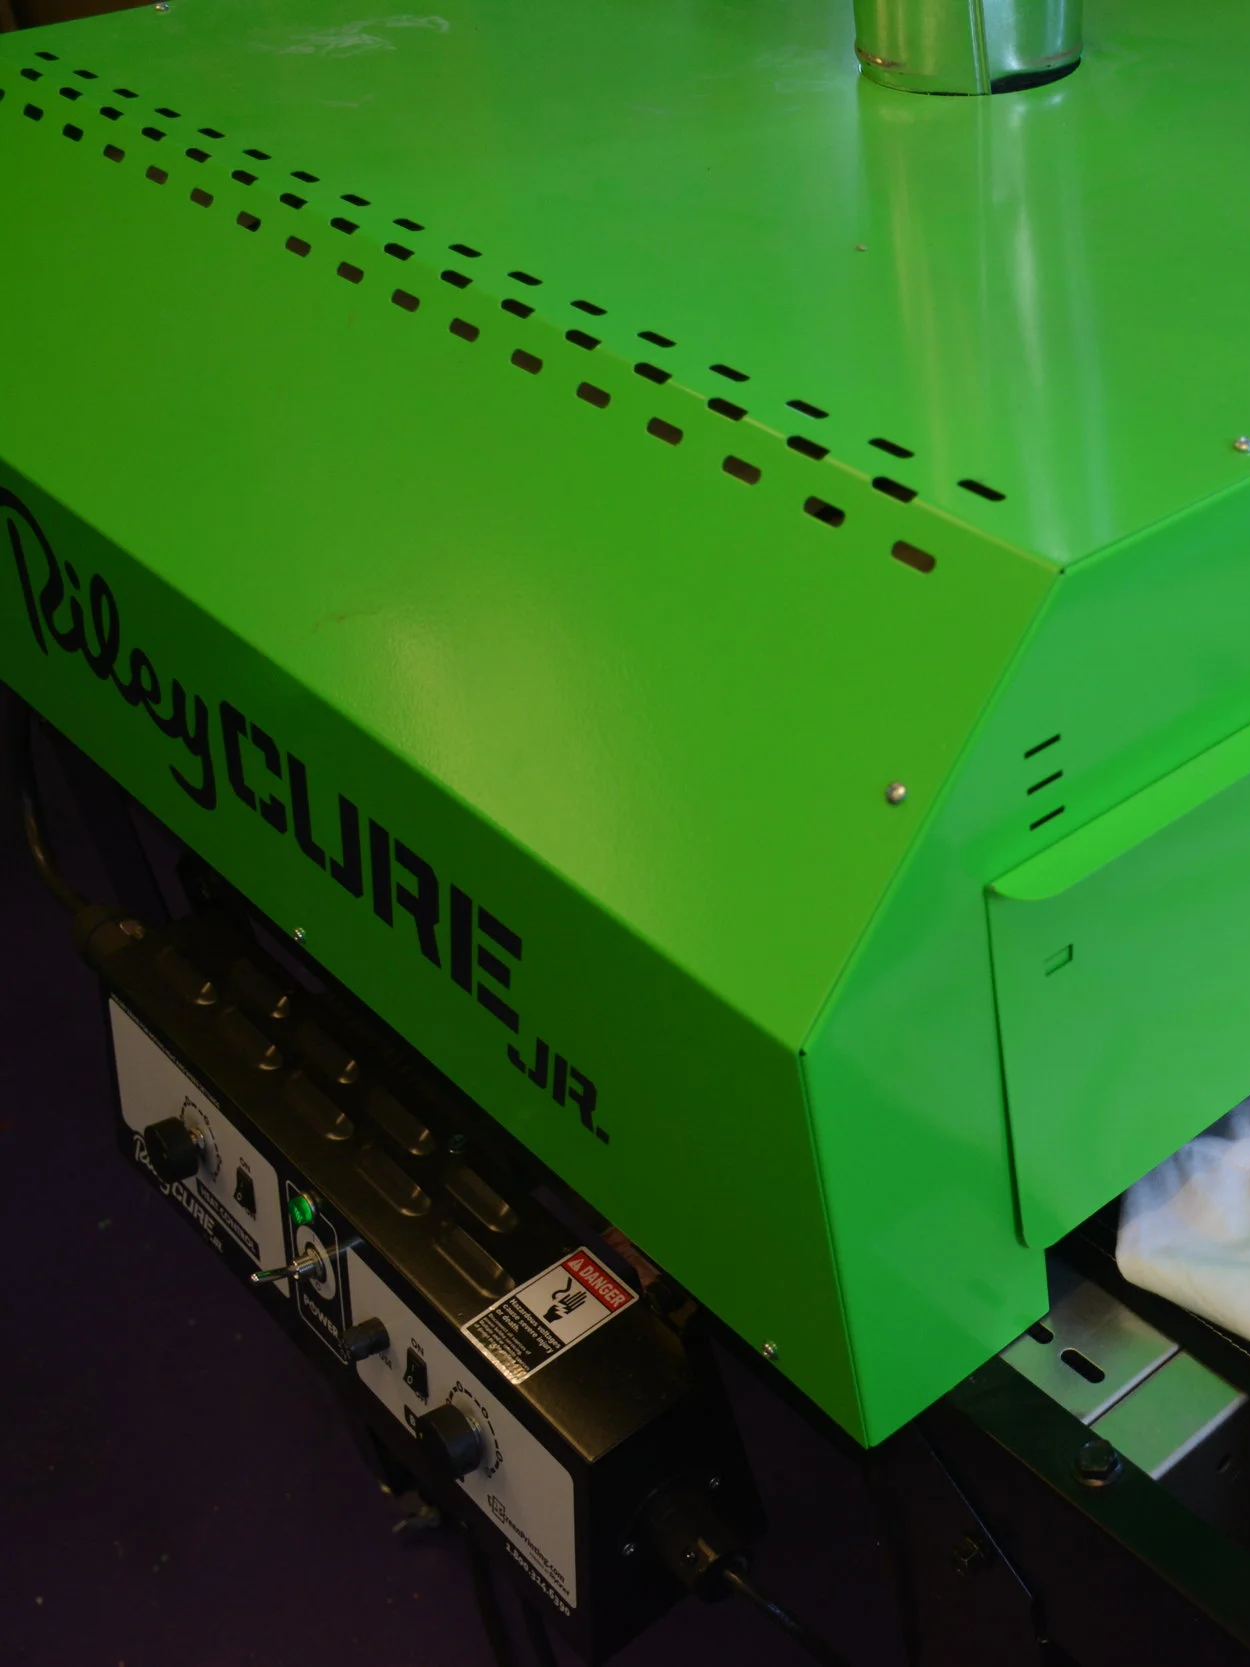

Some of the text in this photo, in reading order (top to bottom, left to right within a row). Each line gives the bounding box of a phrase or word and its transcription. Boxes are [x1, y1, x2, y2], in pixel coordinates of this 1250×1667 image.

[219, 700, 523, 1034] CURE
[579, 1264, 626, 1308] DANGER
[502, 1303, 520, 1322] cause
[509, 1298, 539, 1328] Hazardous
